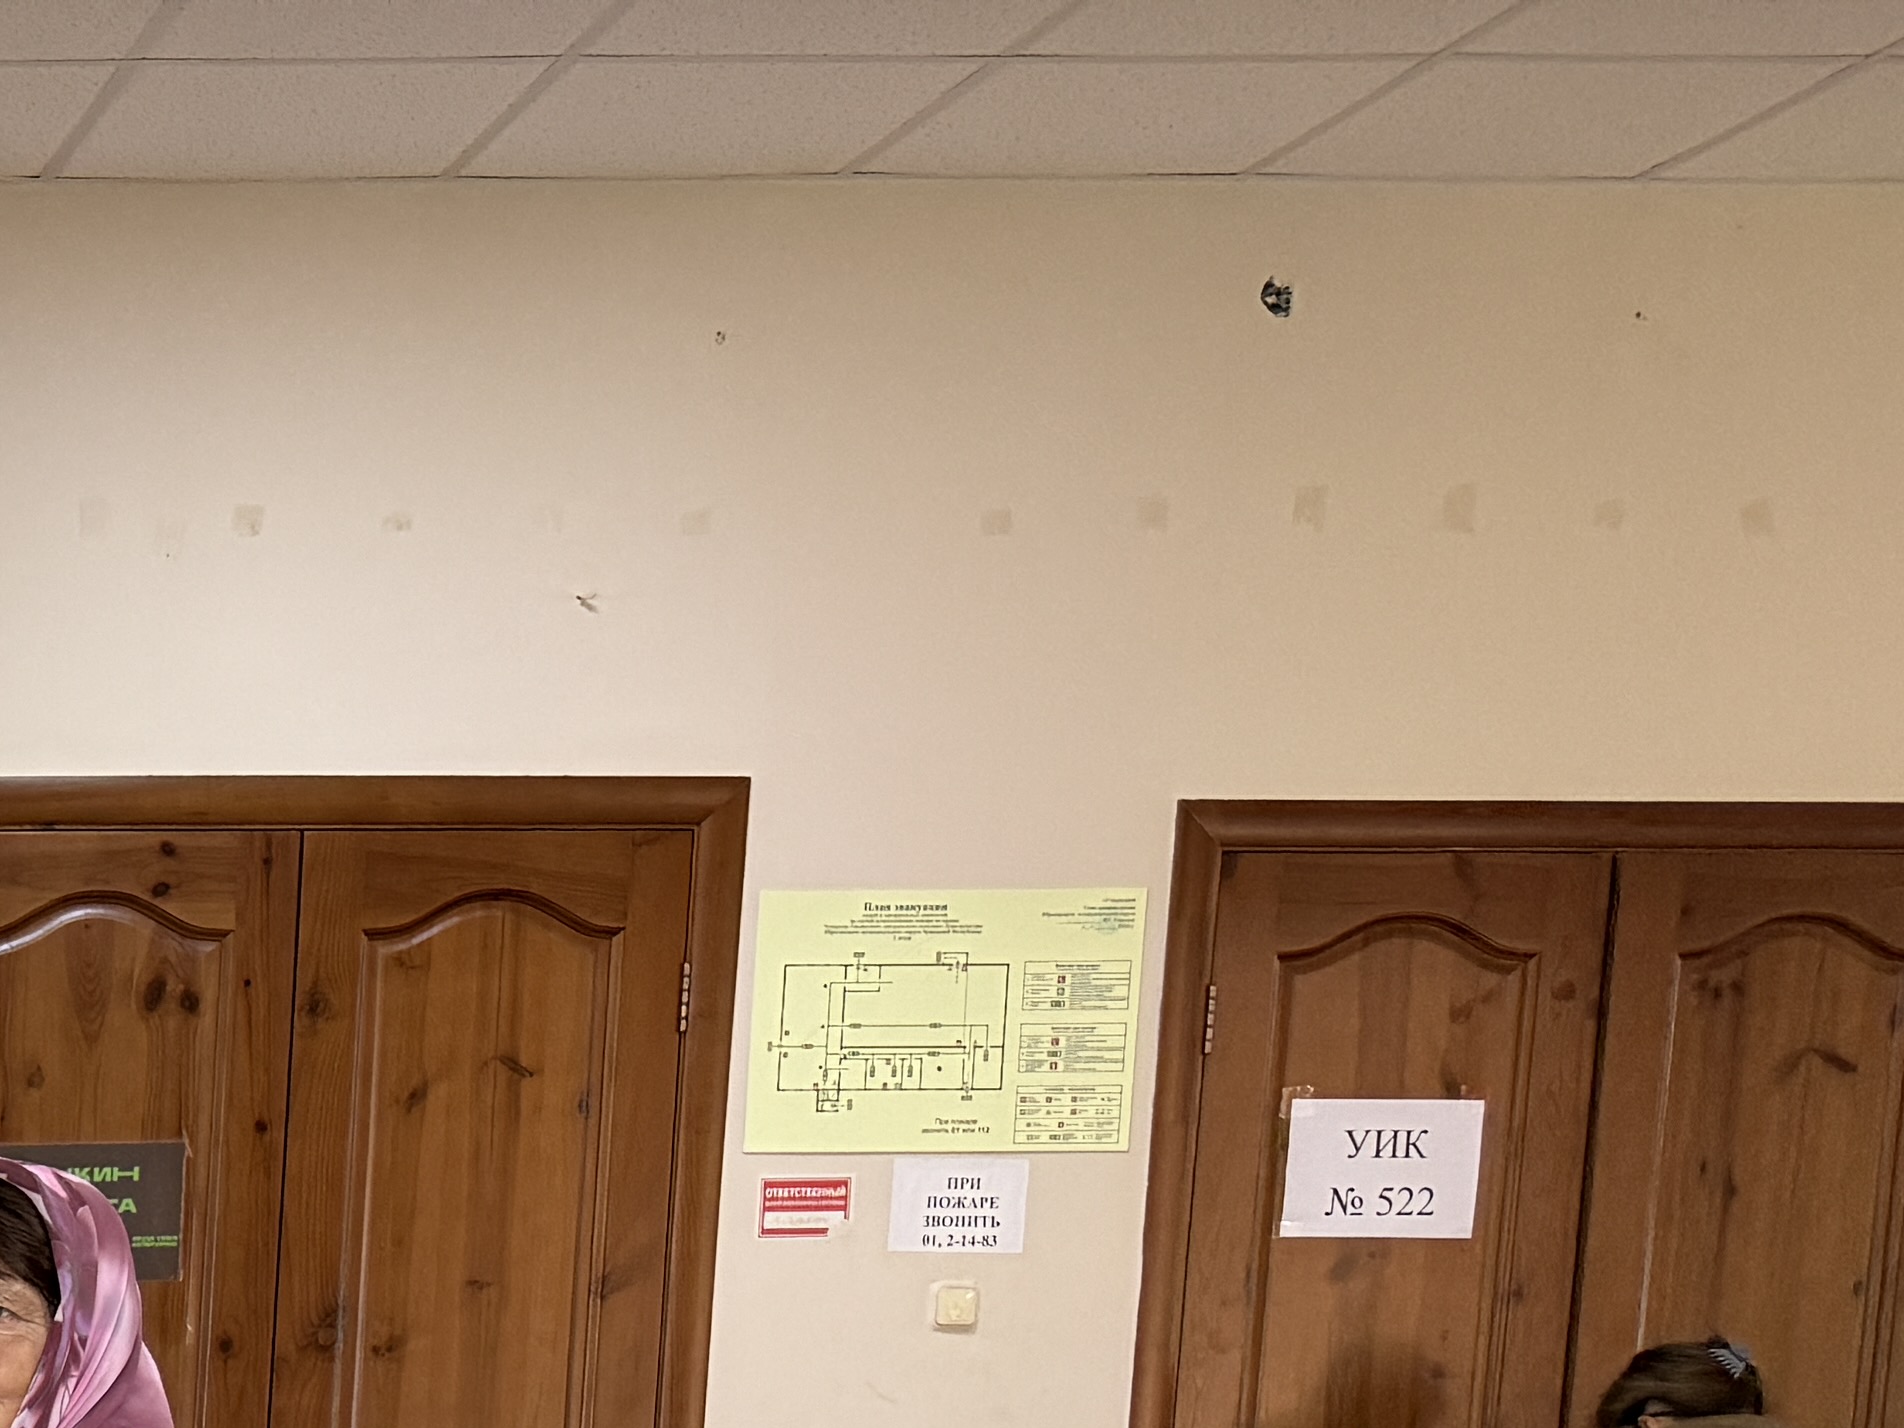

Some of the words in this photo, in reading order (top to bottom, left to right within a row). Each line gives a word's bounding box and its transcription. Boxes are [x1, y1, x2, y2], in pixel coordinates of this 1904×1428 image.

[1345, 1129, 1429, 1159] УИК
[947, 1177, 981, 1191] ПРИ
[927, 1195, 1000, 1209] ПОЖАРЕ
[1324, 1187, 1364, 1217] №
[1375, 1186, 1434, 1217] 522
[922, 1215, 1001, 1228] ЗВОНИТЬ
[922, 1234, 942, 1249] 01,
